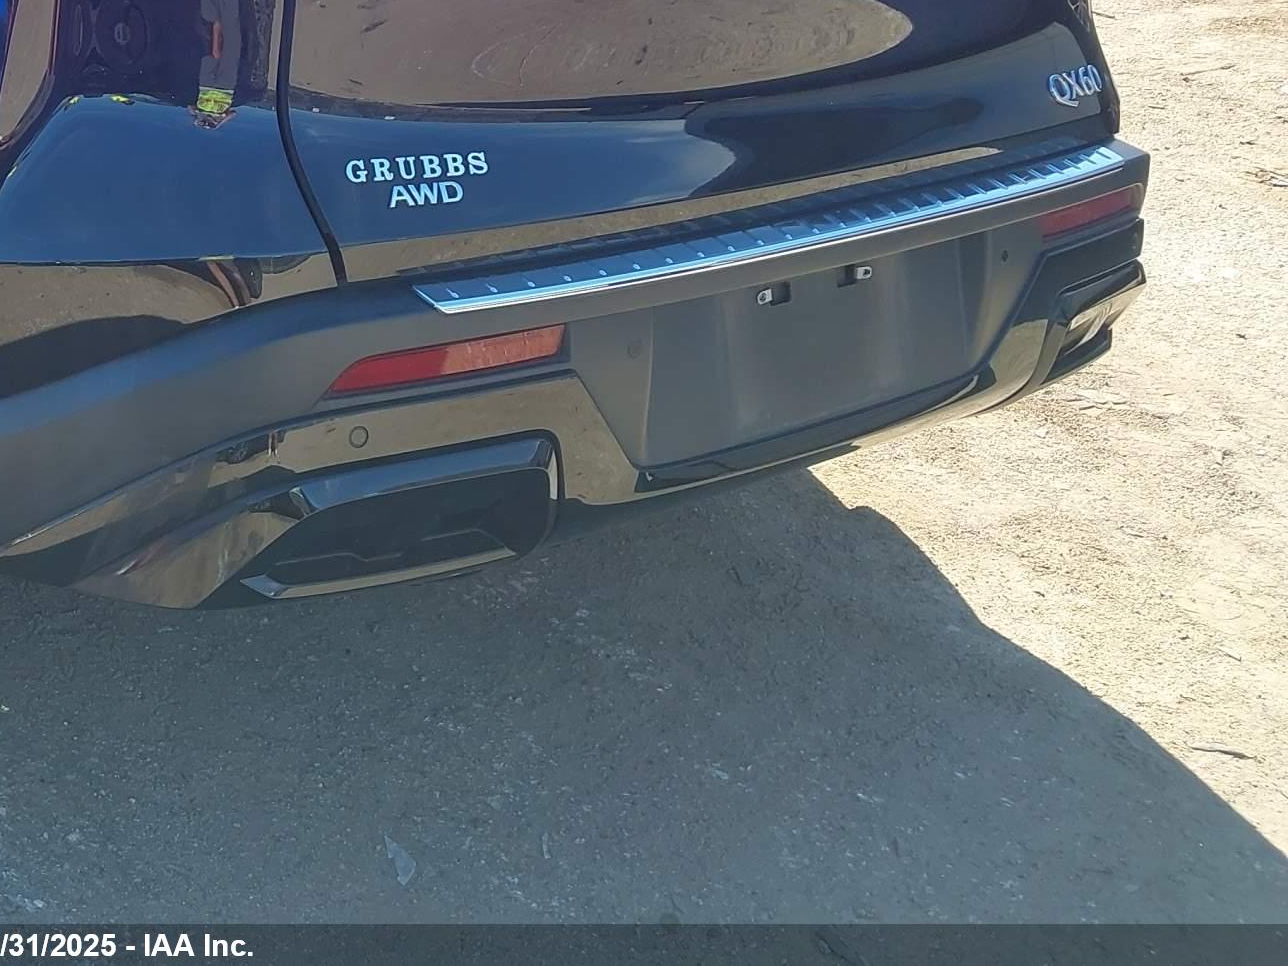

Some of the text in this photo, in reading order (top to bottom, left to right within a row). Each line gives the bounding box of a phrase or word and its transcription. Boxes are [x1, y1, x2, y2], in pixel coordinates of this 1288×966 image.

[1049, 64, 1102, 108] QX60
[345, 151, 490, 184] GRUBBS
[388, 180, 465, 209] AWD
